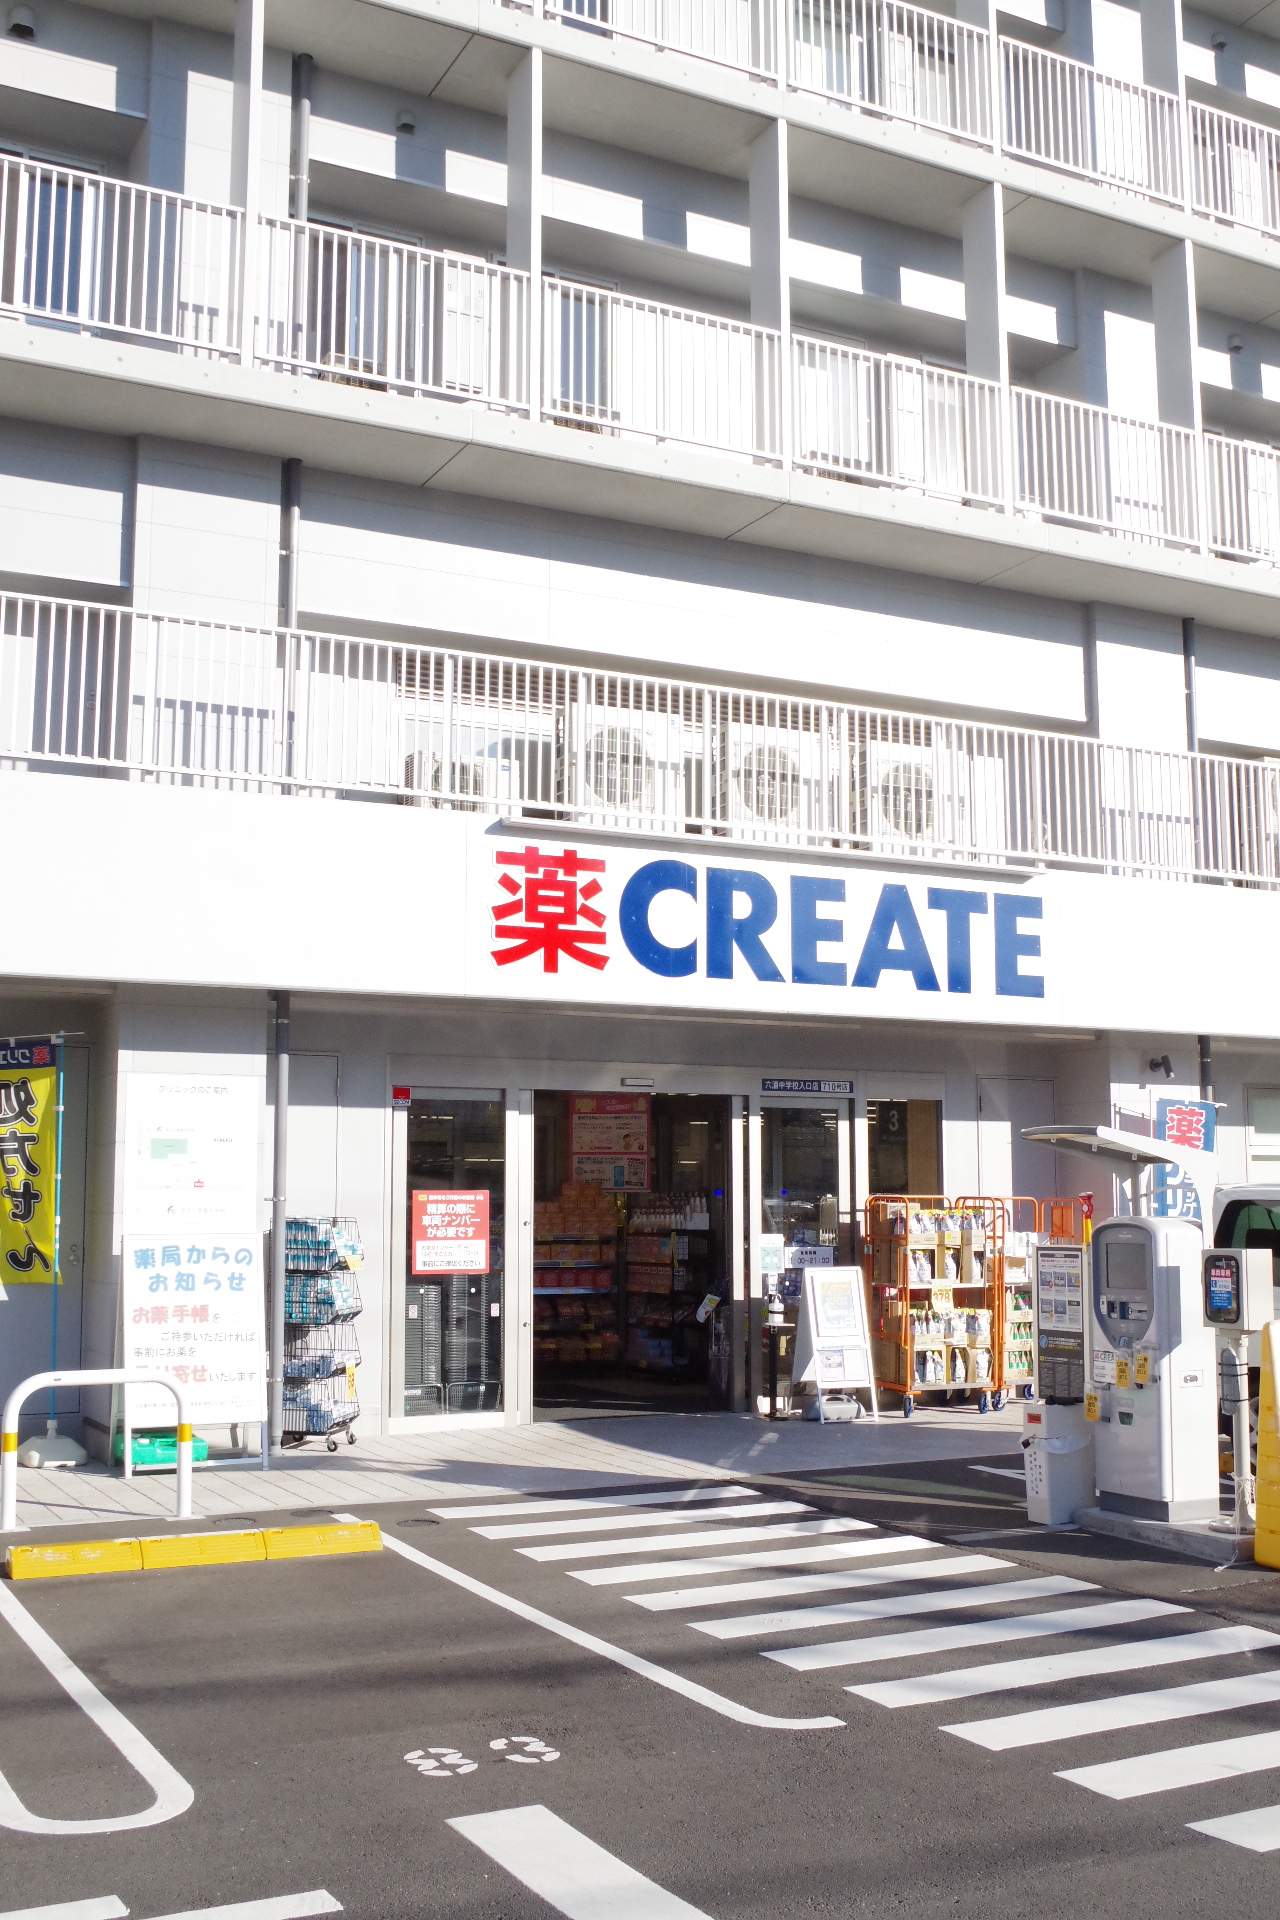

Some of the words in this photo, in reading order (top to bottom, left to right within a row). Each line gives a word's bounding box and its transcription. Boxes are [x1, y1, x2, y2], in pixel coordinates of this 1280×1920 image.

[490, 845, 611, 974] 薬
[618, 858, 1046, 999] CREATE
[888, 1110, 899, 1131] 3
[1166, 1106, 1205, 1150] 薬
[132, 1244, 254, 1269] 薬局からの
[148, 1270, 247, 1293] お知らせ
[160, 1330, 257, 1343] ご持参いただければ
[133, 1346, 198, 1358] 事前にお薬を
[403, 1736, 561, 1776] 83
